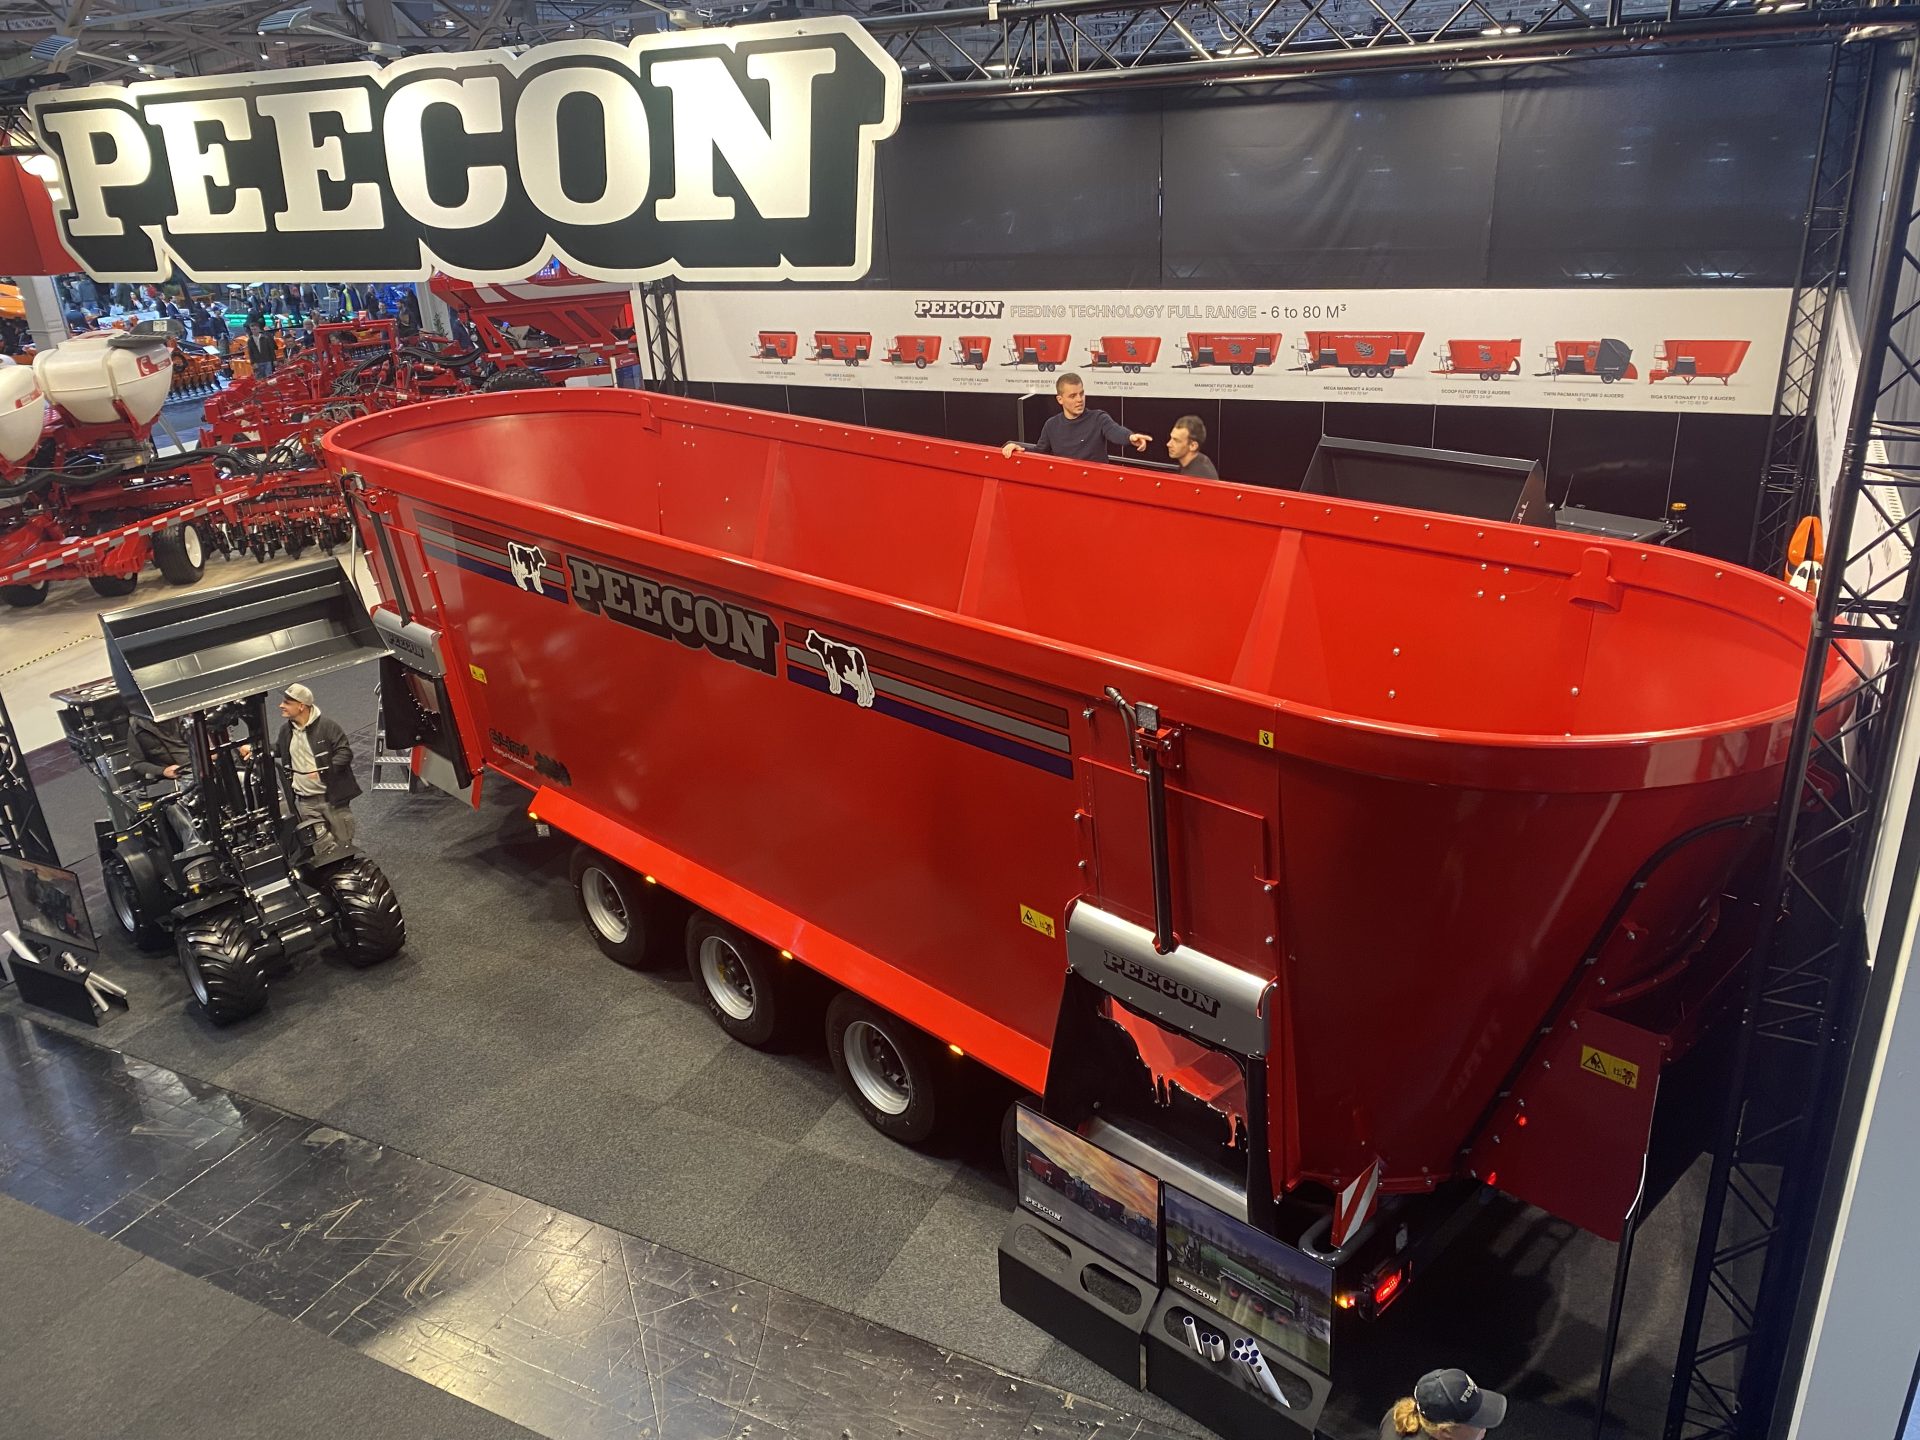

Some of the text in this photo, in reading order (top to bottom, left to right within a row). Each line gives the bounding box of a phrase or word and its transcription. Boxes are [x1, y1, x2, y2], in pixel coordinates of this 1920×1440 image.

[42, 47, 840, 242] PEECON
[915, 300, 1004, 319] PEECON
[1010, 304, 1066, 318] FEEDING
[1070, 304, 1164, 319] TECHNOLOGY
[1168, 304, 1202, 319] FULL
[1205, 304, 1257, 319] RANGE
[1271, 305, 1280, 319] 6
[1284, 306, 1298, 319] to
[1302, 305, 1321, 319] 80
[567, 555, 774, 666] PEECON
[1103, 949, 1221, 1018] PEECON
[1024, 1195, 1063, 1222] PEECON
[1175, 1275, 1219, 1306] PEECON
